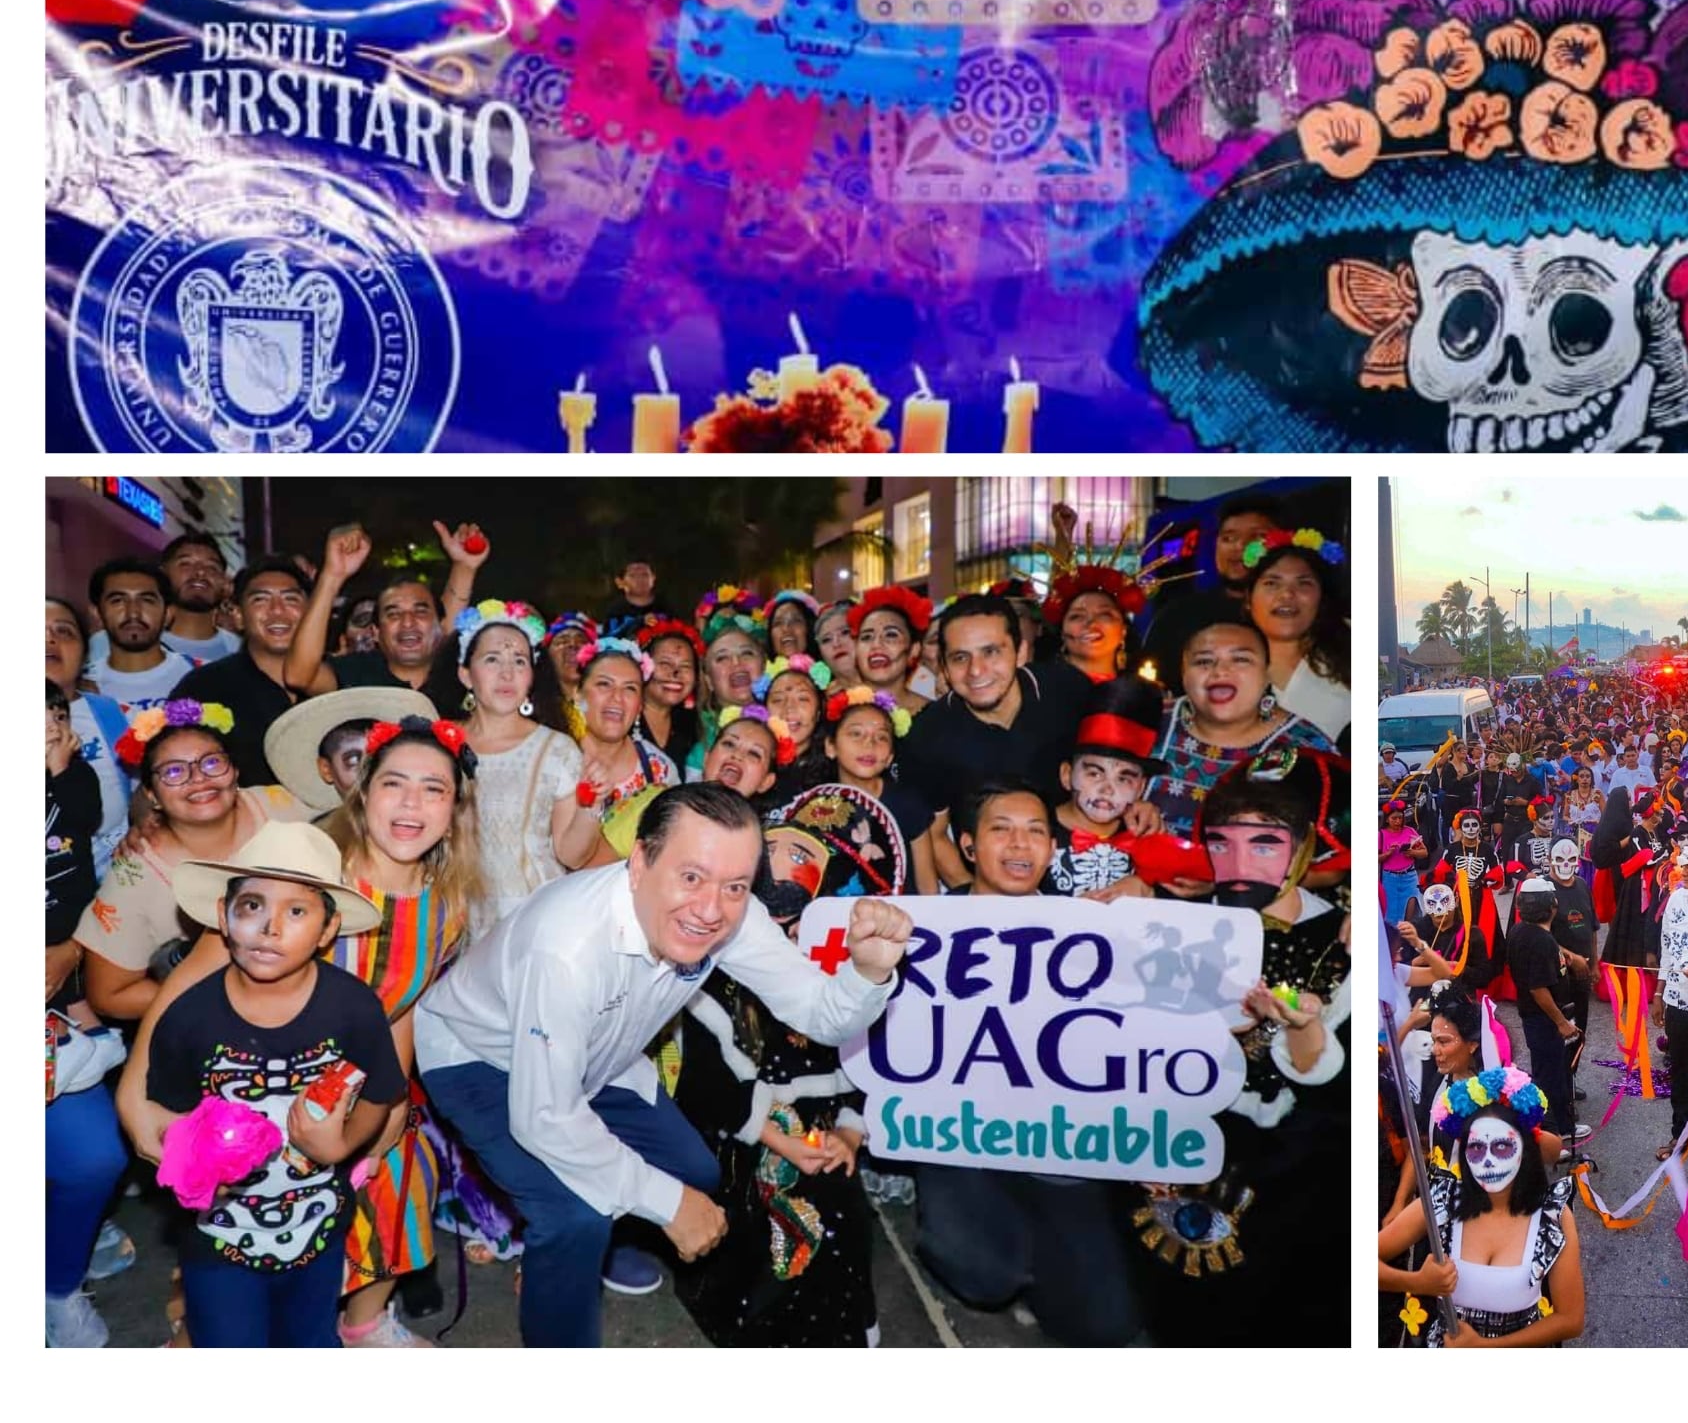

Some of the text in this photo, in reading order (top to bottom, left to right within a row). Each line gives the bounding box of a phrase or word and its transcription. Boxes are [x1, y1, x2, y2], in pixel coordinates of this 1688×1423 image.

[201, 21, 347, 68] DESFILE
[346, 266, 404, 452] DE GUERRERO
[890, 925, 1114, 1004] RETO
[868, 1004, 1220, 1097] UAGro
[880, 1095, 1207, 1169] Sustentable
